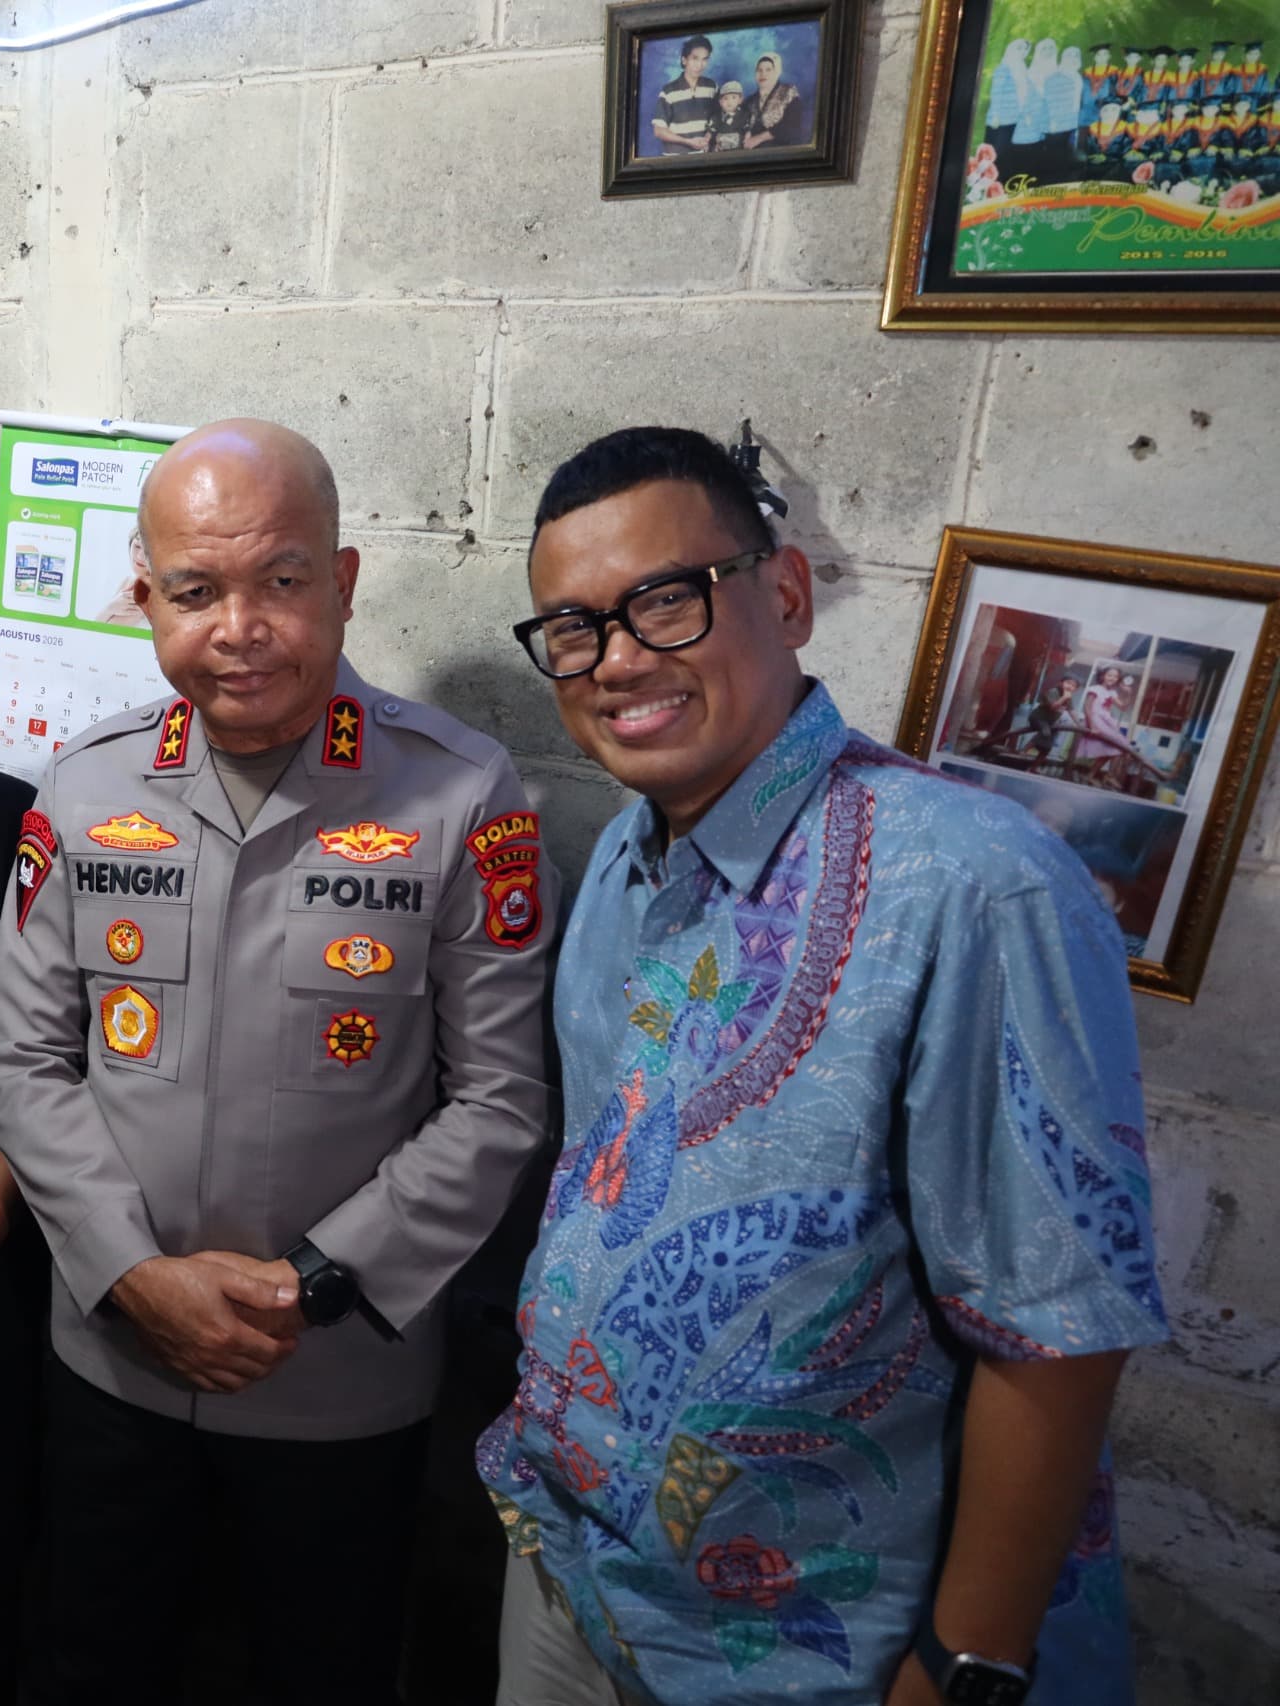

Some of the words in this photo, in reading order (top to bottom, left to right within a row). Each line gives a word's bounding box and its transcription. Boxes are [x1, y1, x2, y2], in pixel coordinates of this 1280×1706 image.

[1120, 250, 1163, 260] 2015
[35, 461, 75, 475] Salonpas
[82, 460, 124, 473] MODERN
[82, 472, 114, 483] PATCH
[0, 628, 41, 643] AGUSTUS
[42, 635, 64, 646] 2026
[13, 681, 19, 690] 2
[40, 686, 46, 694] 3
[67, 691, 73, 699] 4
[95, 696, 101, 705] 5
[124, 701, 130, 710] 6
[11, 699, 17, 707] 9
[35, 703, 44, 712] 10
[63, 709, 71, 717] 11
[90, 713, 99, 722] 12
[6, 716, 15, 725] 16
[33, 721, 42, 729] 17
[60, 726, 69, 735] 18
[474, 816, 535, 853] POLDA
[484, 851, 533, 870] BANTEN
[76, 862, 185, 898] HENGKI
[304, 874, 424, 913] POLRI
[352, 940, 370, 948] SAR
